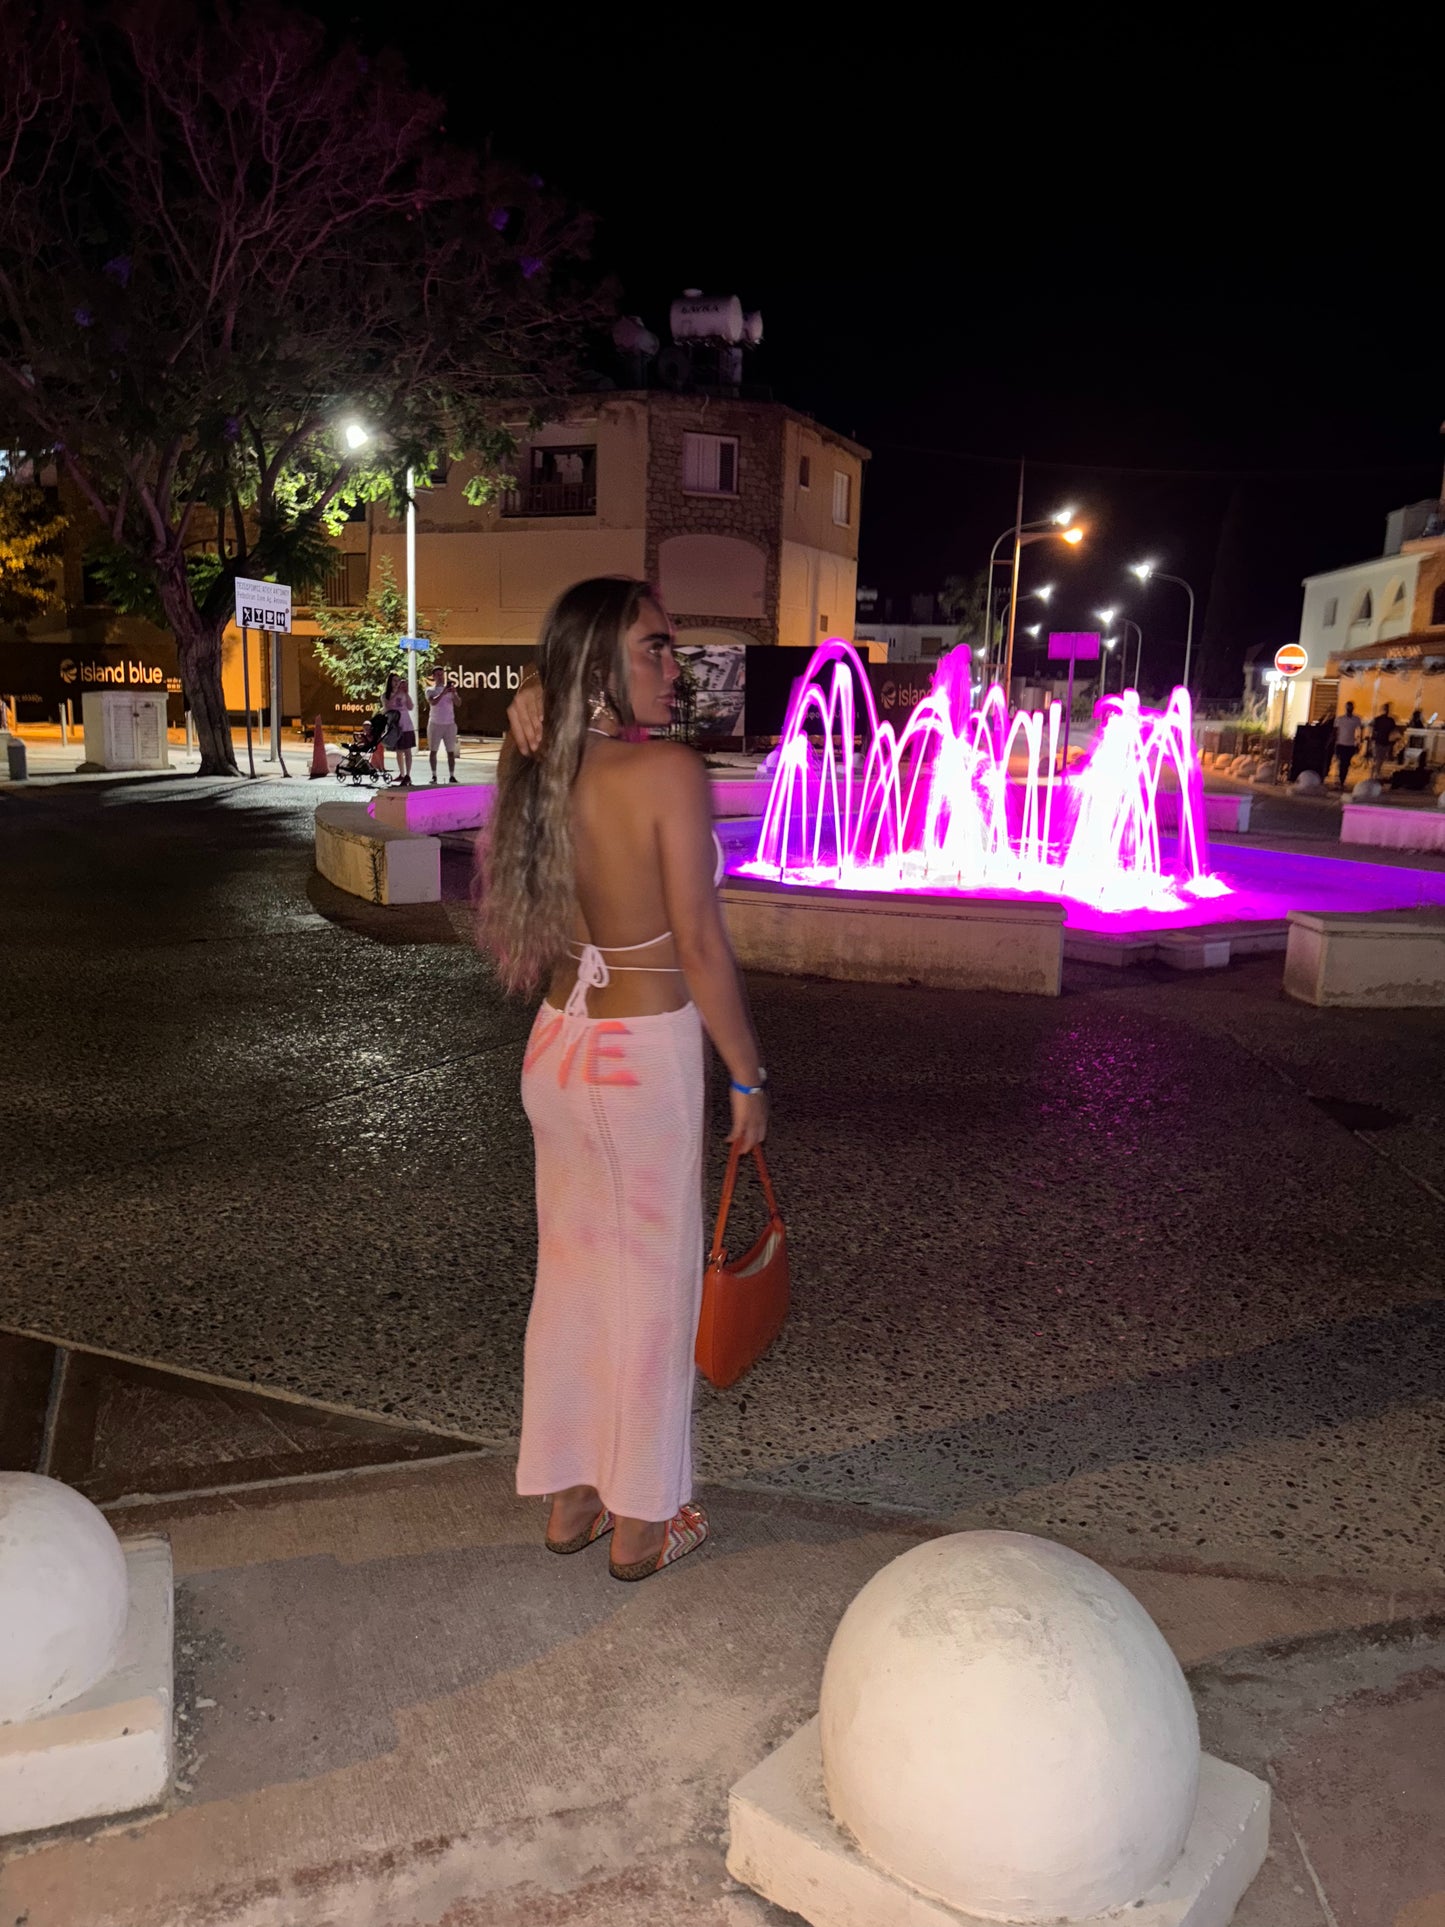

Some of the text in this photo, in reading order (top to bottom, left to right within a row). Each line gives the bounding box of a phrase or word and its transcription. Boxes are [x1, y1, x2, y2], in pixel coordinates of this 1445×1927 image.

[80, 660, 163, 684] island blue
[443, 664, 524, 690] island bl
[898, 682, 933, 707] islan
